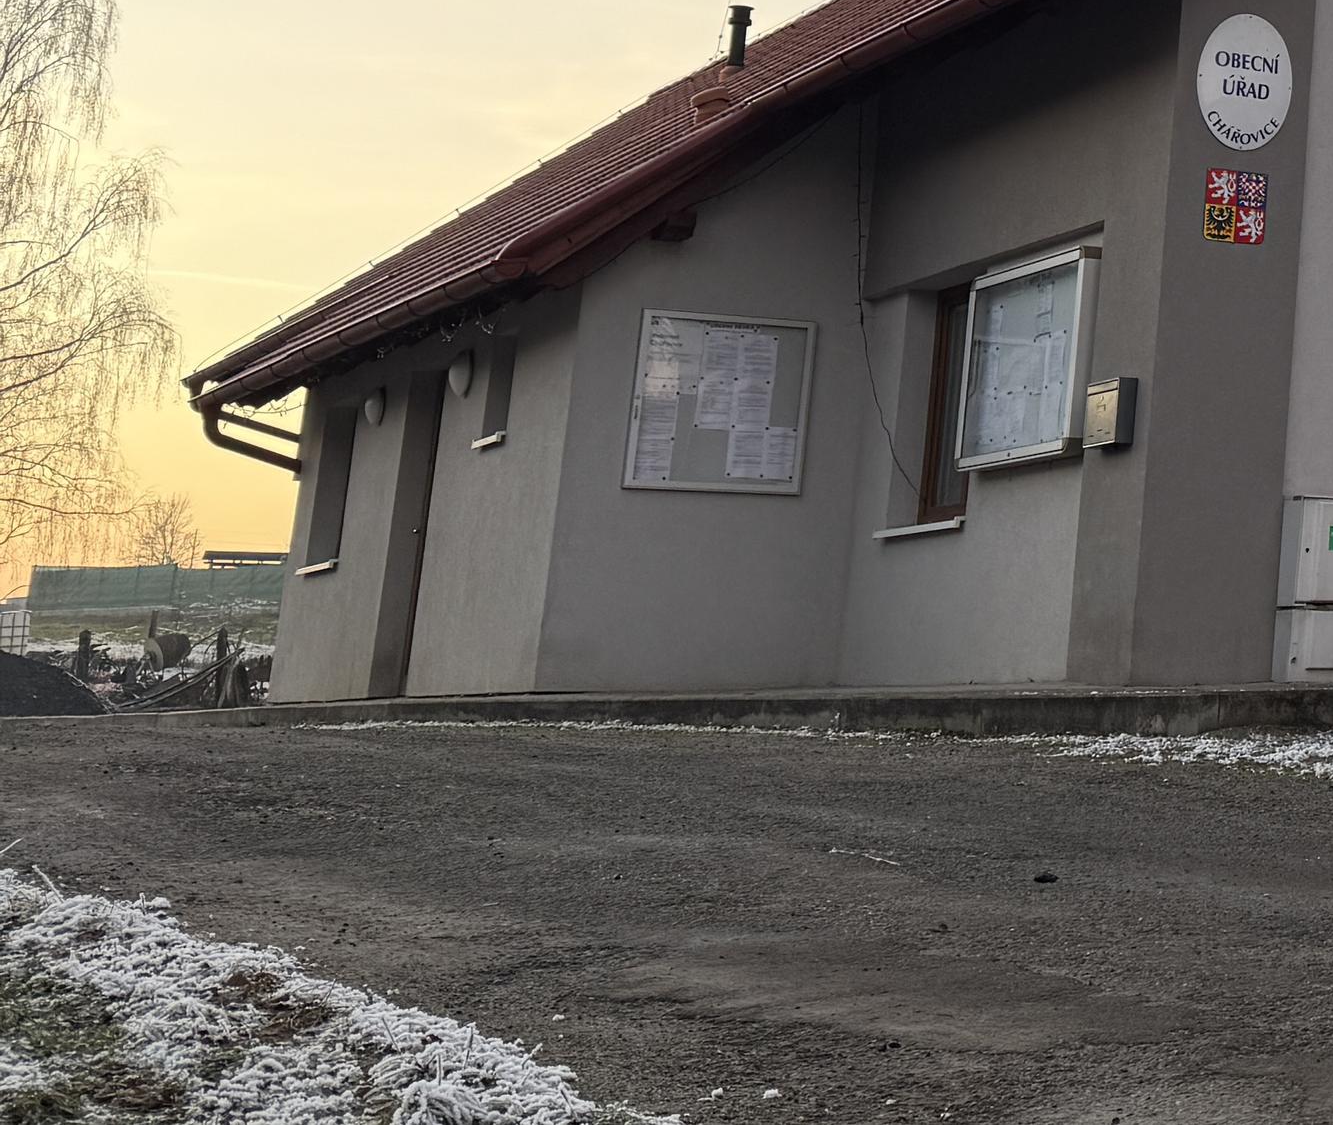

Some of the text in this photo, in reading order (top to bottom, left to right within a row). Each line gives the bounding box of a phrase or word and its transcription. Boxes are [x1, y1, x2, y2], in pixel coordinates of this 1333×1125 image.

[1215, 50, 1280, 75] OBECNÍ
[1223, 74, 1270, 101] ÚŘAD
[1207, 110, 1280, 146] CHÁŘOVICE
